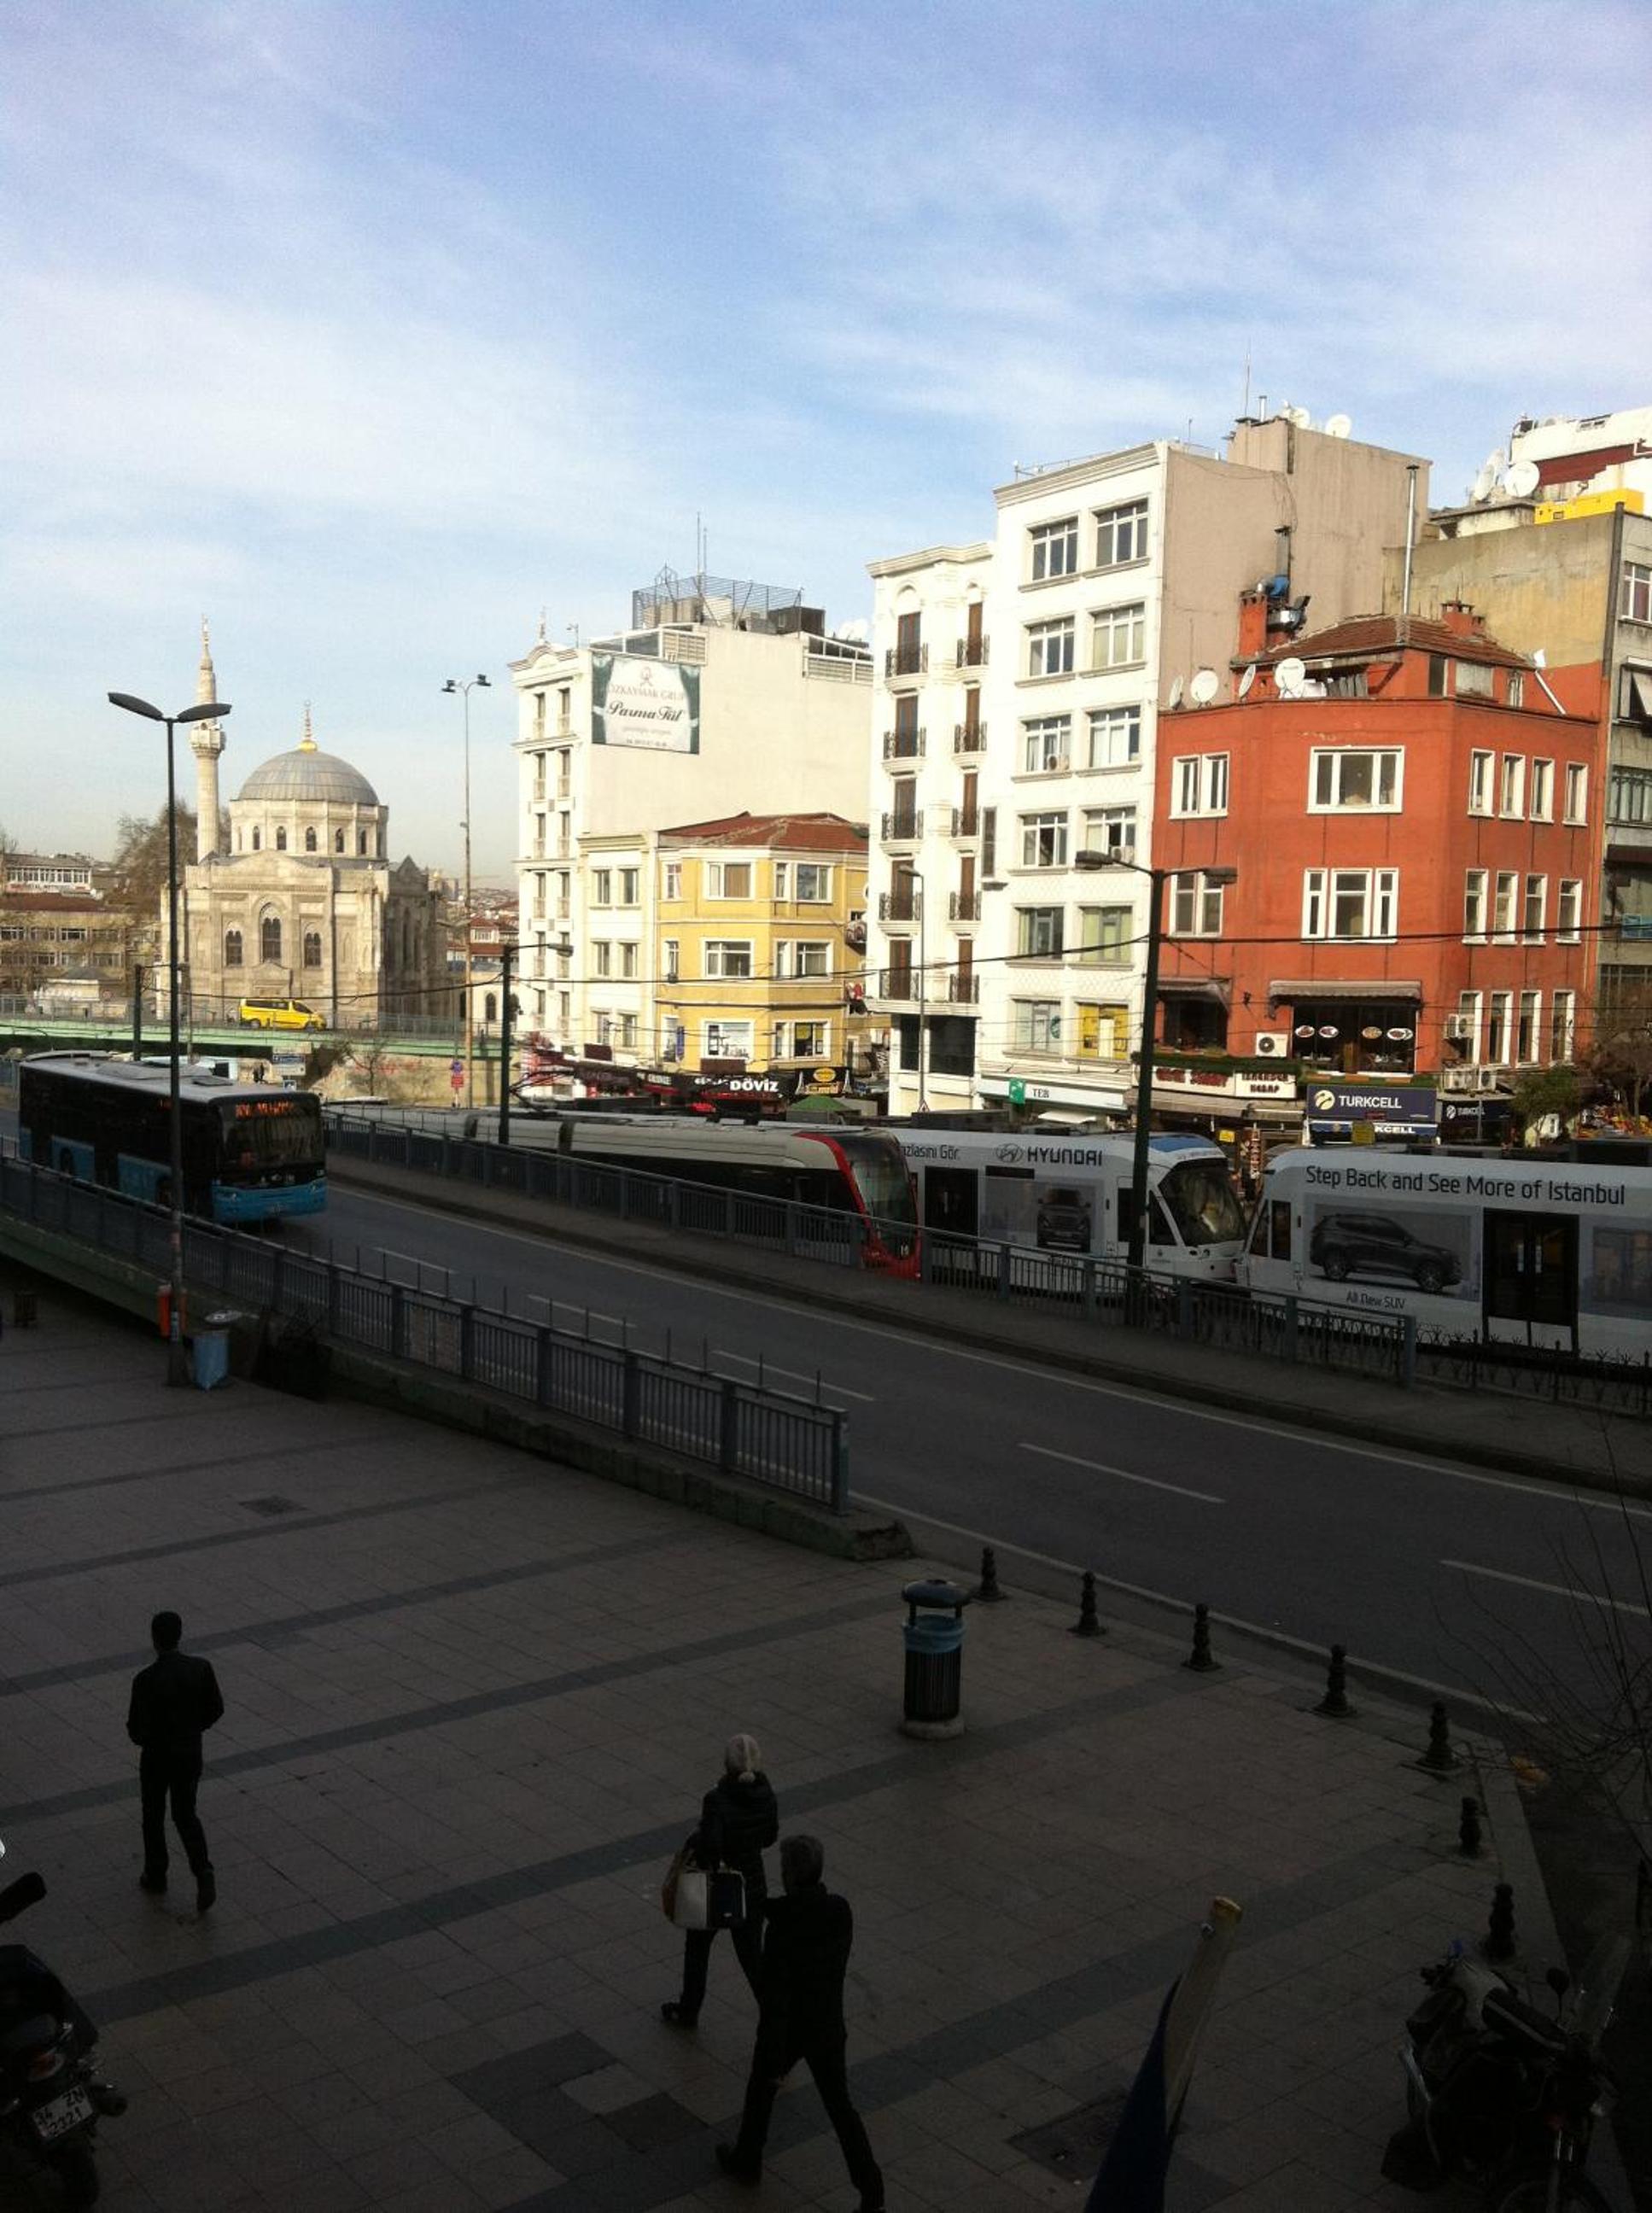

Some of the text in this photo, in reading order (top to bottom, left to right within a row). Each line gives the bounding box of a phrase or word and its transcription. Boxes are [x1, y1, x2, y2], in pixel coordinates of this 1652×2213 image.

[730, 1077, 779, 1092] DÖVİZ
[1339, 1095, 1402, 1109] TURKCELL
[1374, 1124, 1416, 1134] KCELL
[1027, 1148, 1103, 1166] HYUNDAI
[1306, 1165, 1625, 1205] Step Back and See More of Istanbul
[1384, 1296, 1407, 1309] SUV
